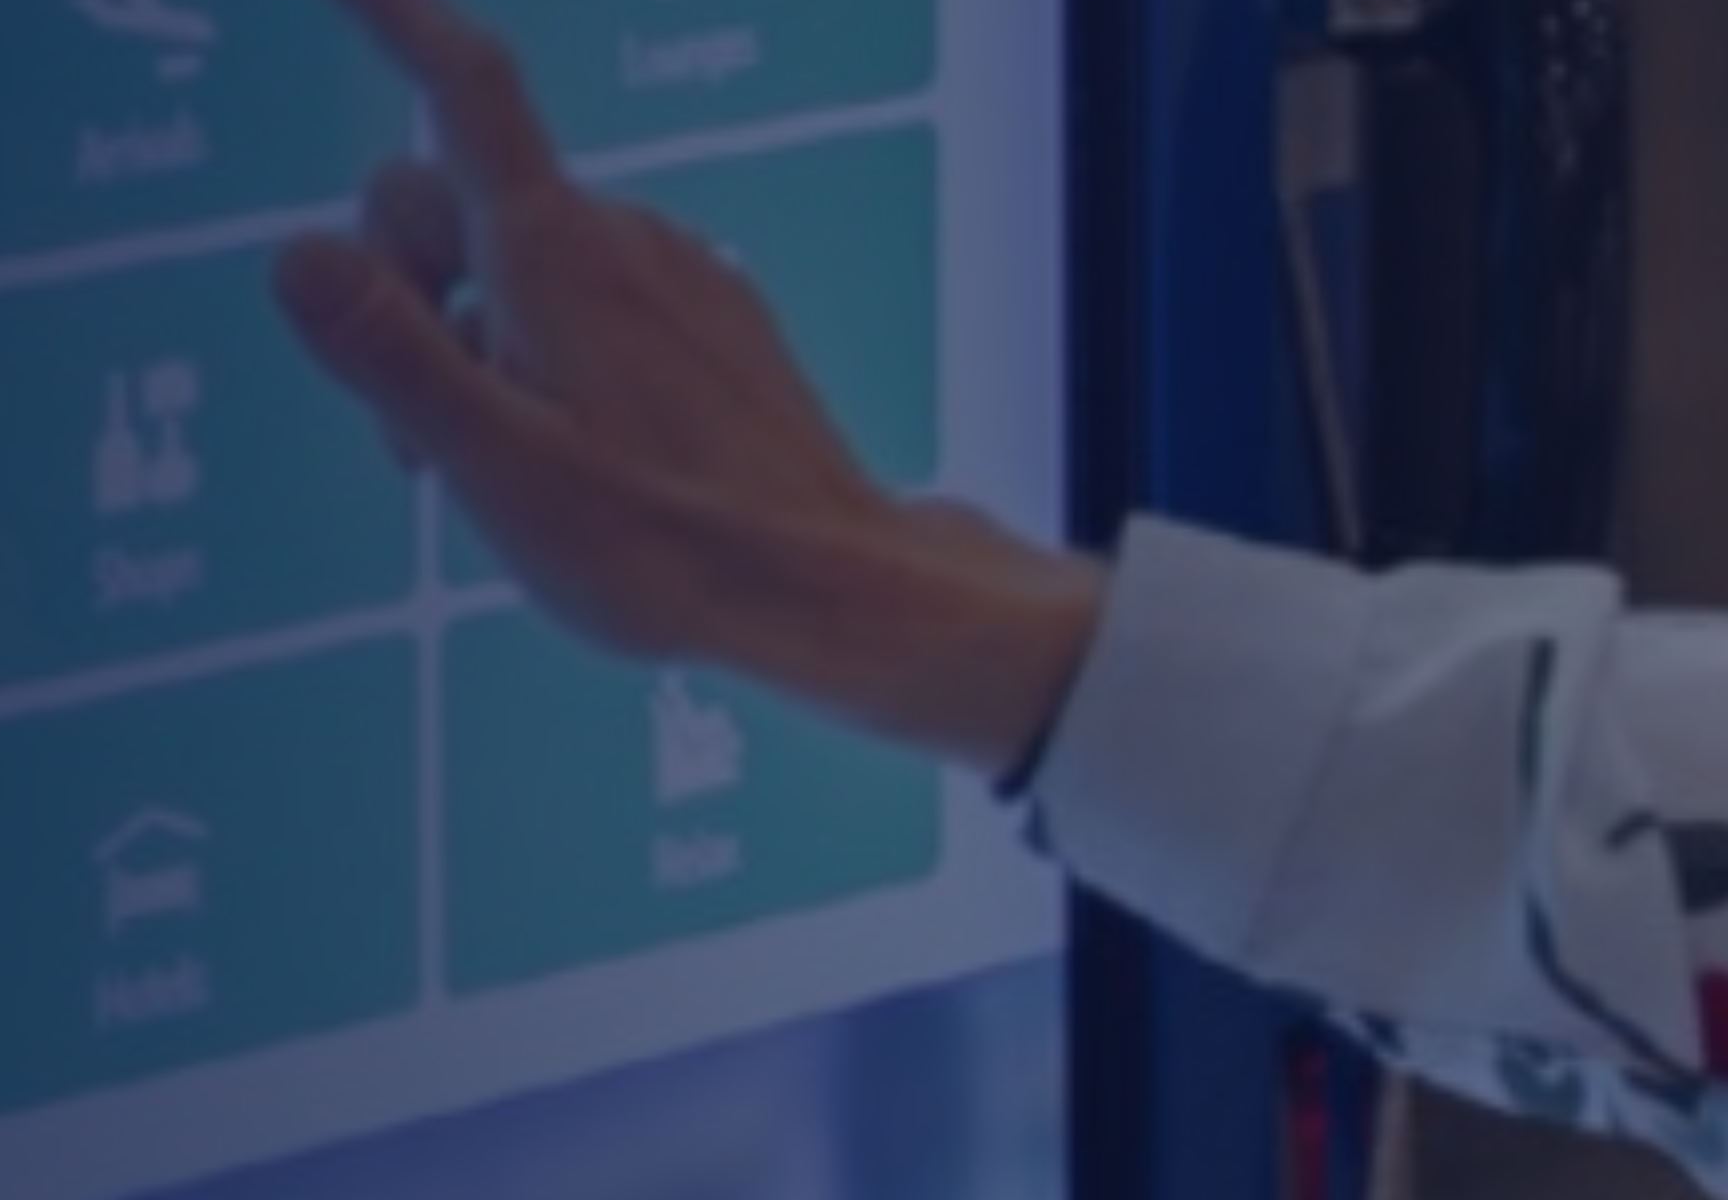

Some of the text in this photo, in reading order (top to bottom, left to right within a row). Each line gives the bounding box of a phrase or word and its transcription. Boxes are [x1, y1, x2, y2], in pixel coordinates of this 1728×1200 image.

[618, 22, 762, 92] Lounges
[74, 108, 210, 187] Arrivals
[88, 542, 206, 615] Shops
[652, 824, 744, 892] Relax
[92, 952, 213, 1038] Hotels
